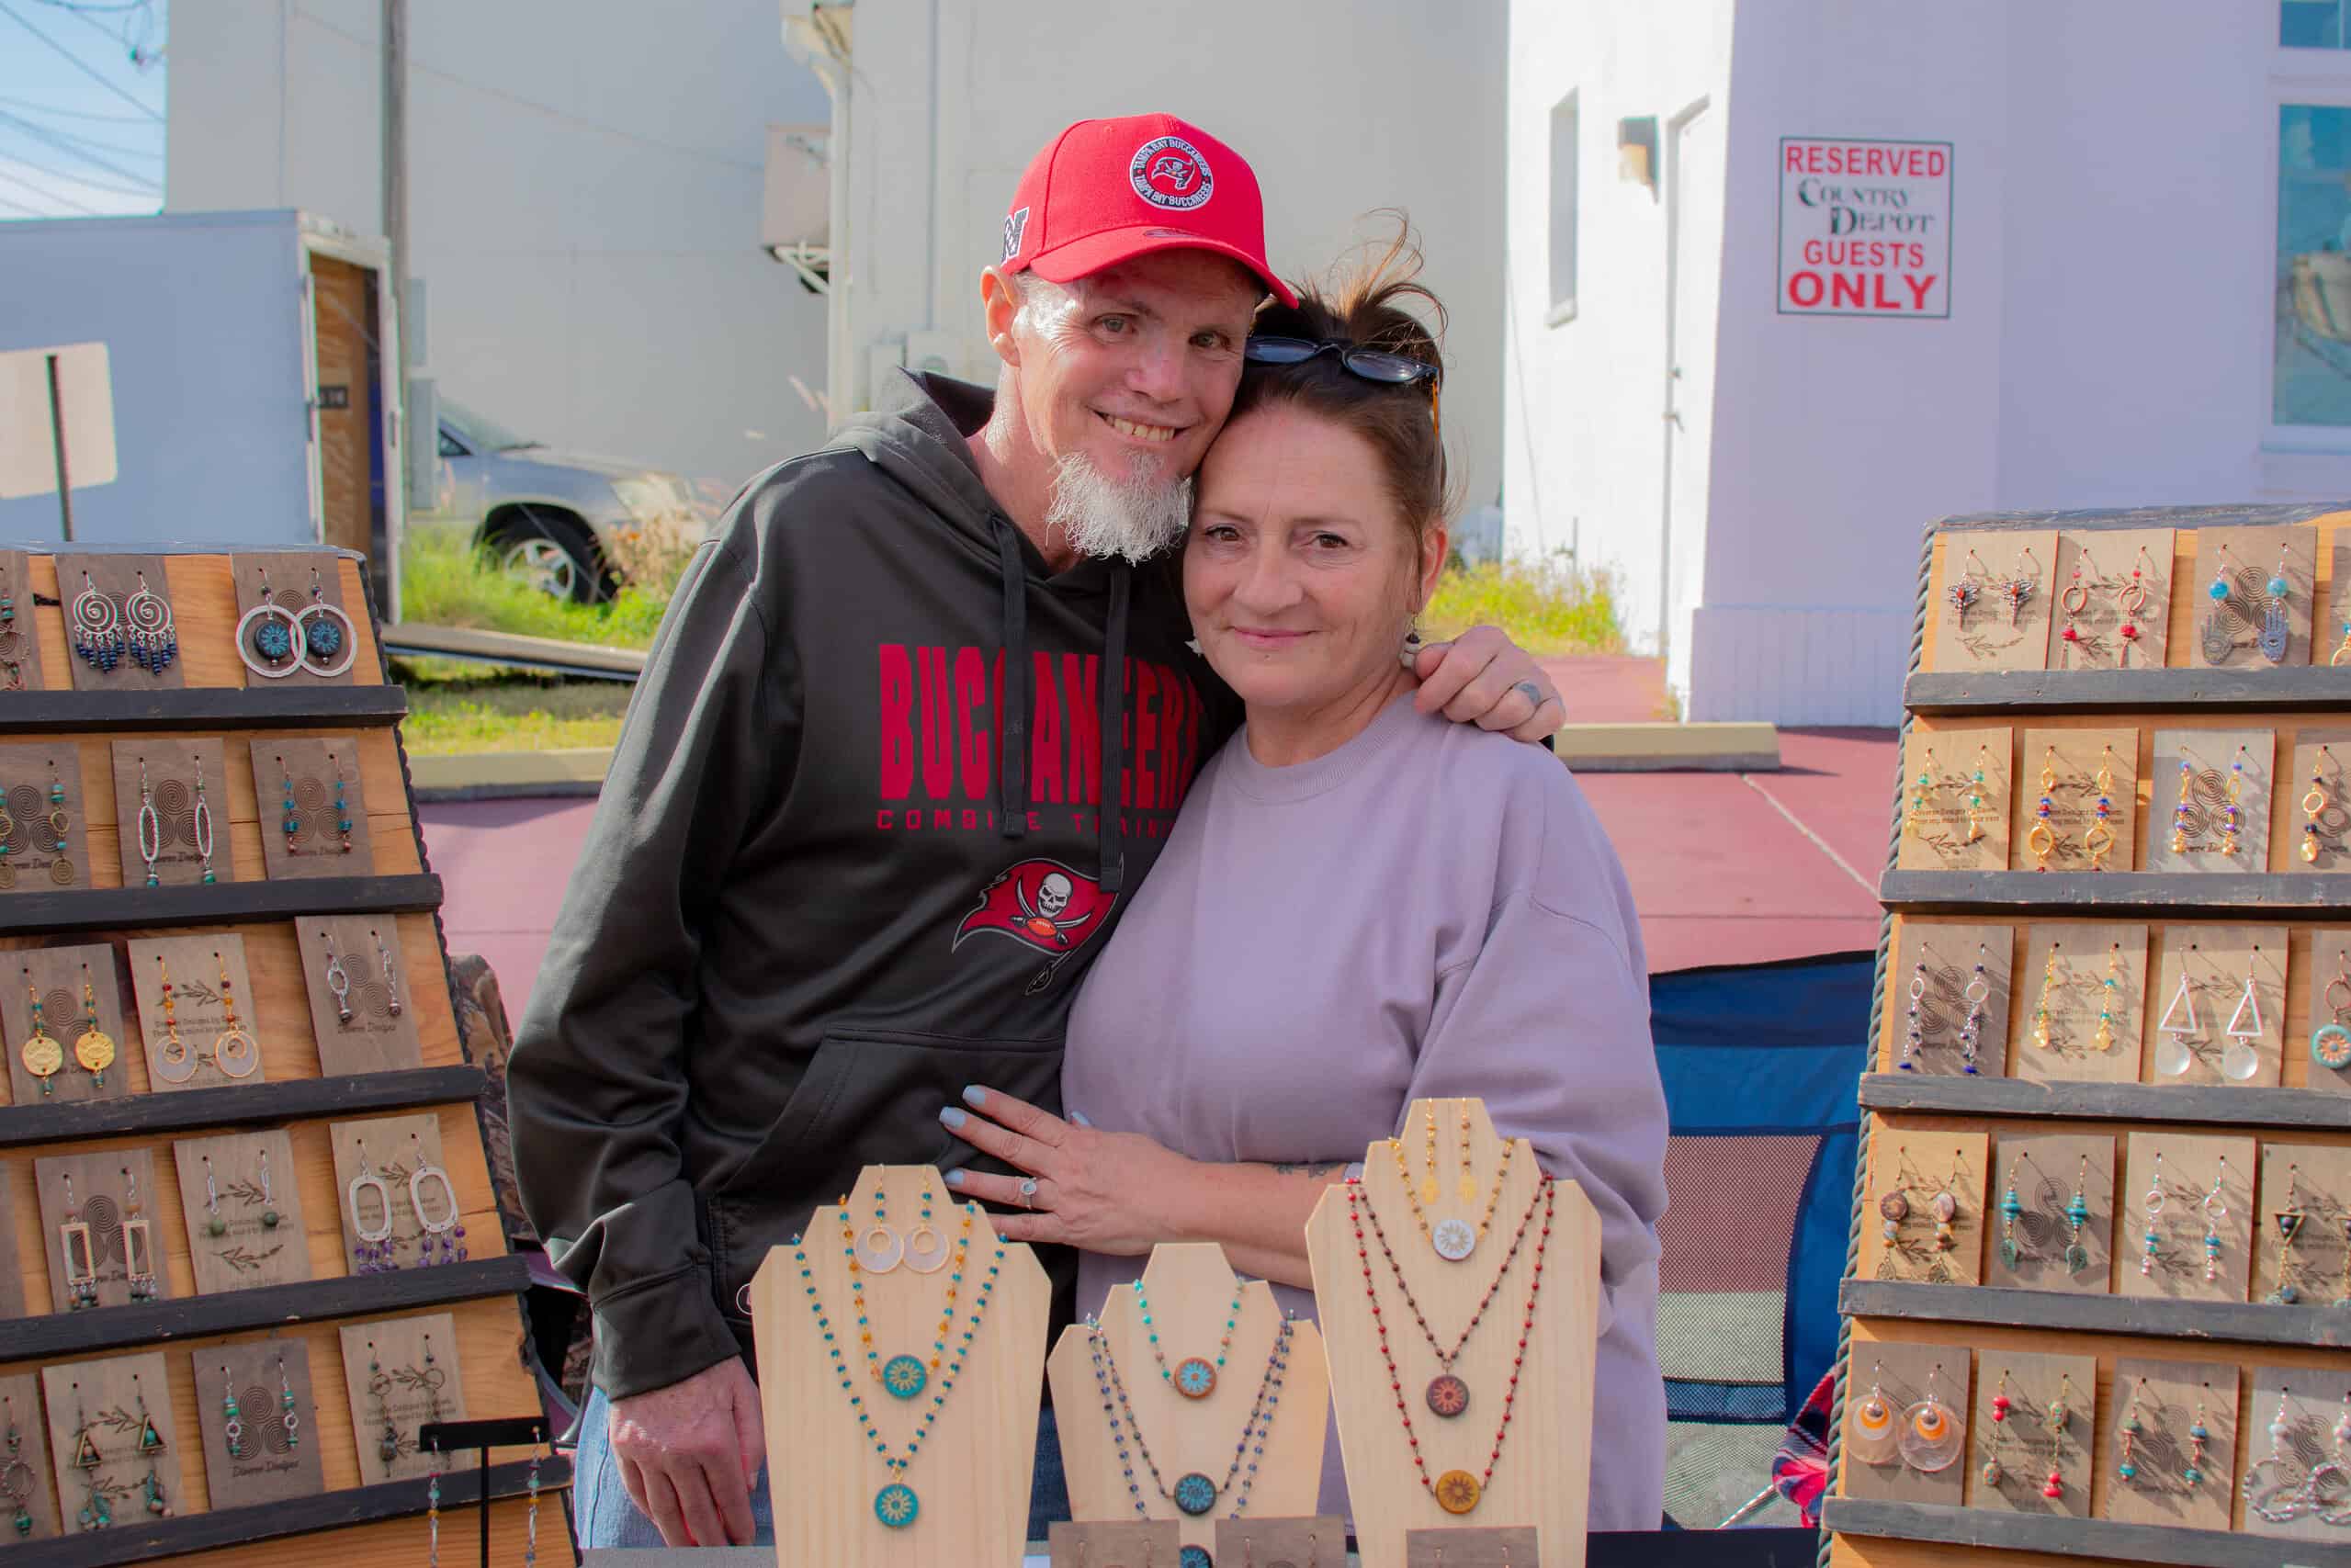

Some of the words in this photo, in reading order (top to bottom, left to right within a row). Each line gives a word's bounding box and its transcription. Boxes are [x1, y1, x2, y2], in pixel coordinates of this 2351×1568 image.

[1786, 147, 1944, 176] RESERVED
[1803, 240, 1925, 268] GUESTS
[1788, 271, 1937, 310] ONLY
[877, 809, 1041, 831] COMBIE
